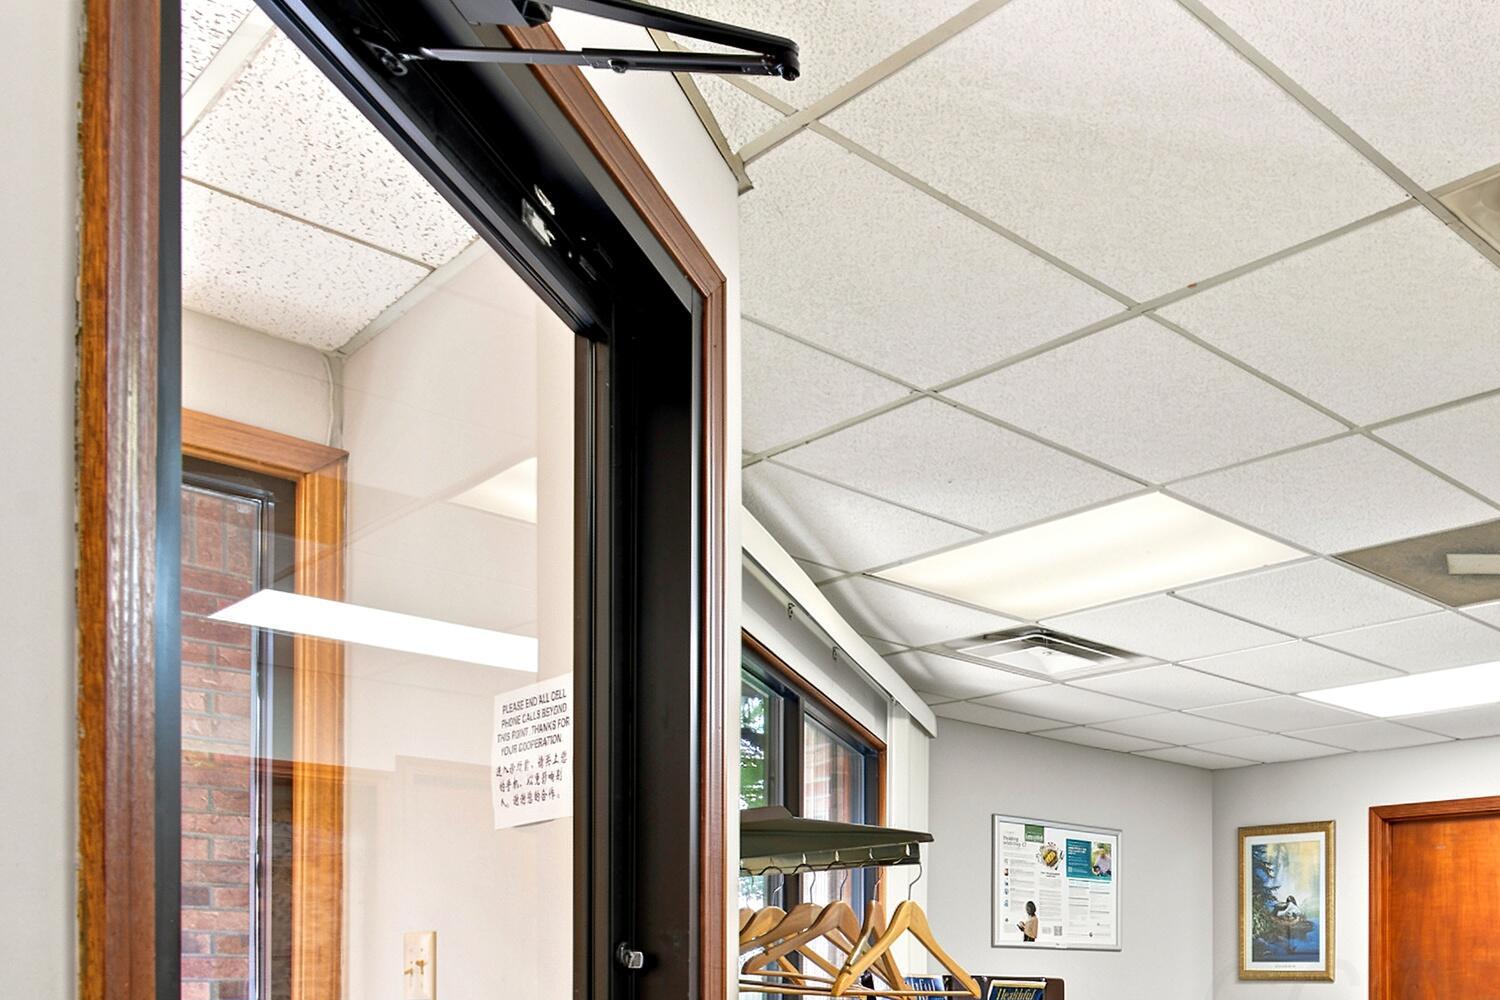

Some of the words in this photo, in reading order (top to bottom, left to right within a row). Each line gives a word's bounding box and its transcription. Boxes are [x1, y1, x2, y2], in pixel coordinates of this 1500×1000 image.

[502, 700, 524, 714] PLEASE
[526, 696, 537, 708] END
[539, 693, 550, 703] ALL
[551, 689, 566, 701] CELL
[501, 715, 521, 728] PHONE
[522, 710, 540, 723] CALLS
[542, 703, 567, 718] BEYOND
[497, 732, 510, 743] THIS
[532, 720, 556, 734] THANKS
[558, 717, 569, 728] FOR
[501, 744, 517, 756] YOUR
[996, 988, 1036, 1000] Healthful
